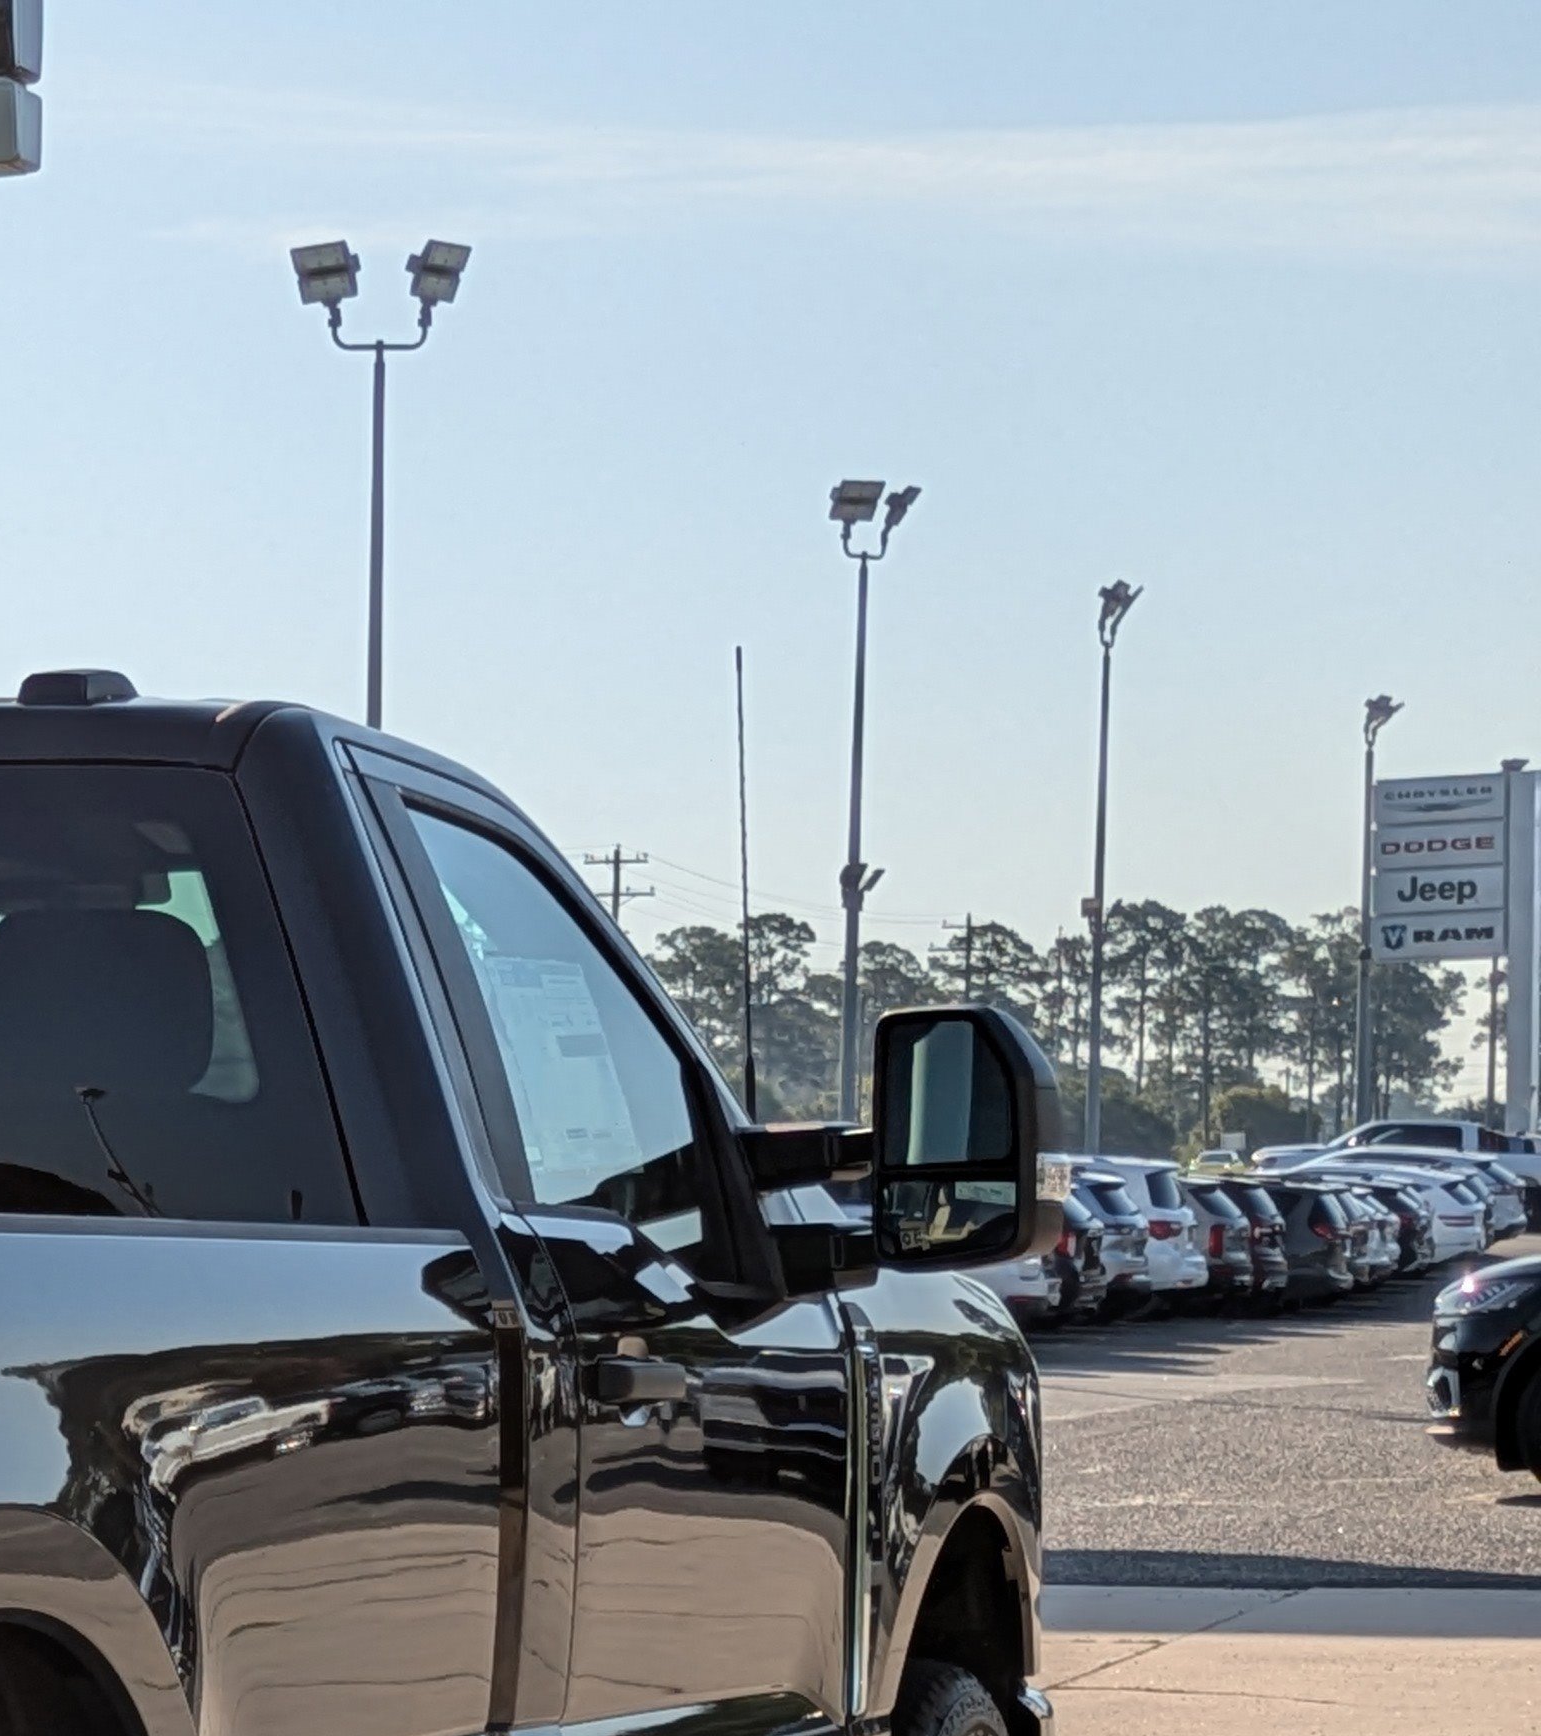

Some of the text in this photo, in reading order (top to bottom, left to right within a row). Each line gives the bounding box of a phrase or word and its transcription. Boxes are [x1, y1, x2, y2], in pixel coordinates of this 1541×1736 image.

[1380, 835, 1495, 855] DODGE
[1397, 876, 1478, 905] Jeep
[1413, 926, 1495, 943] RAM
